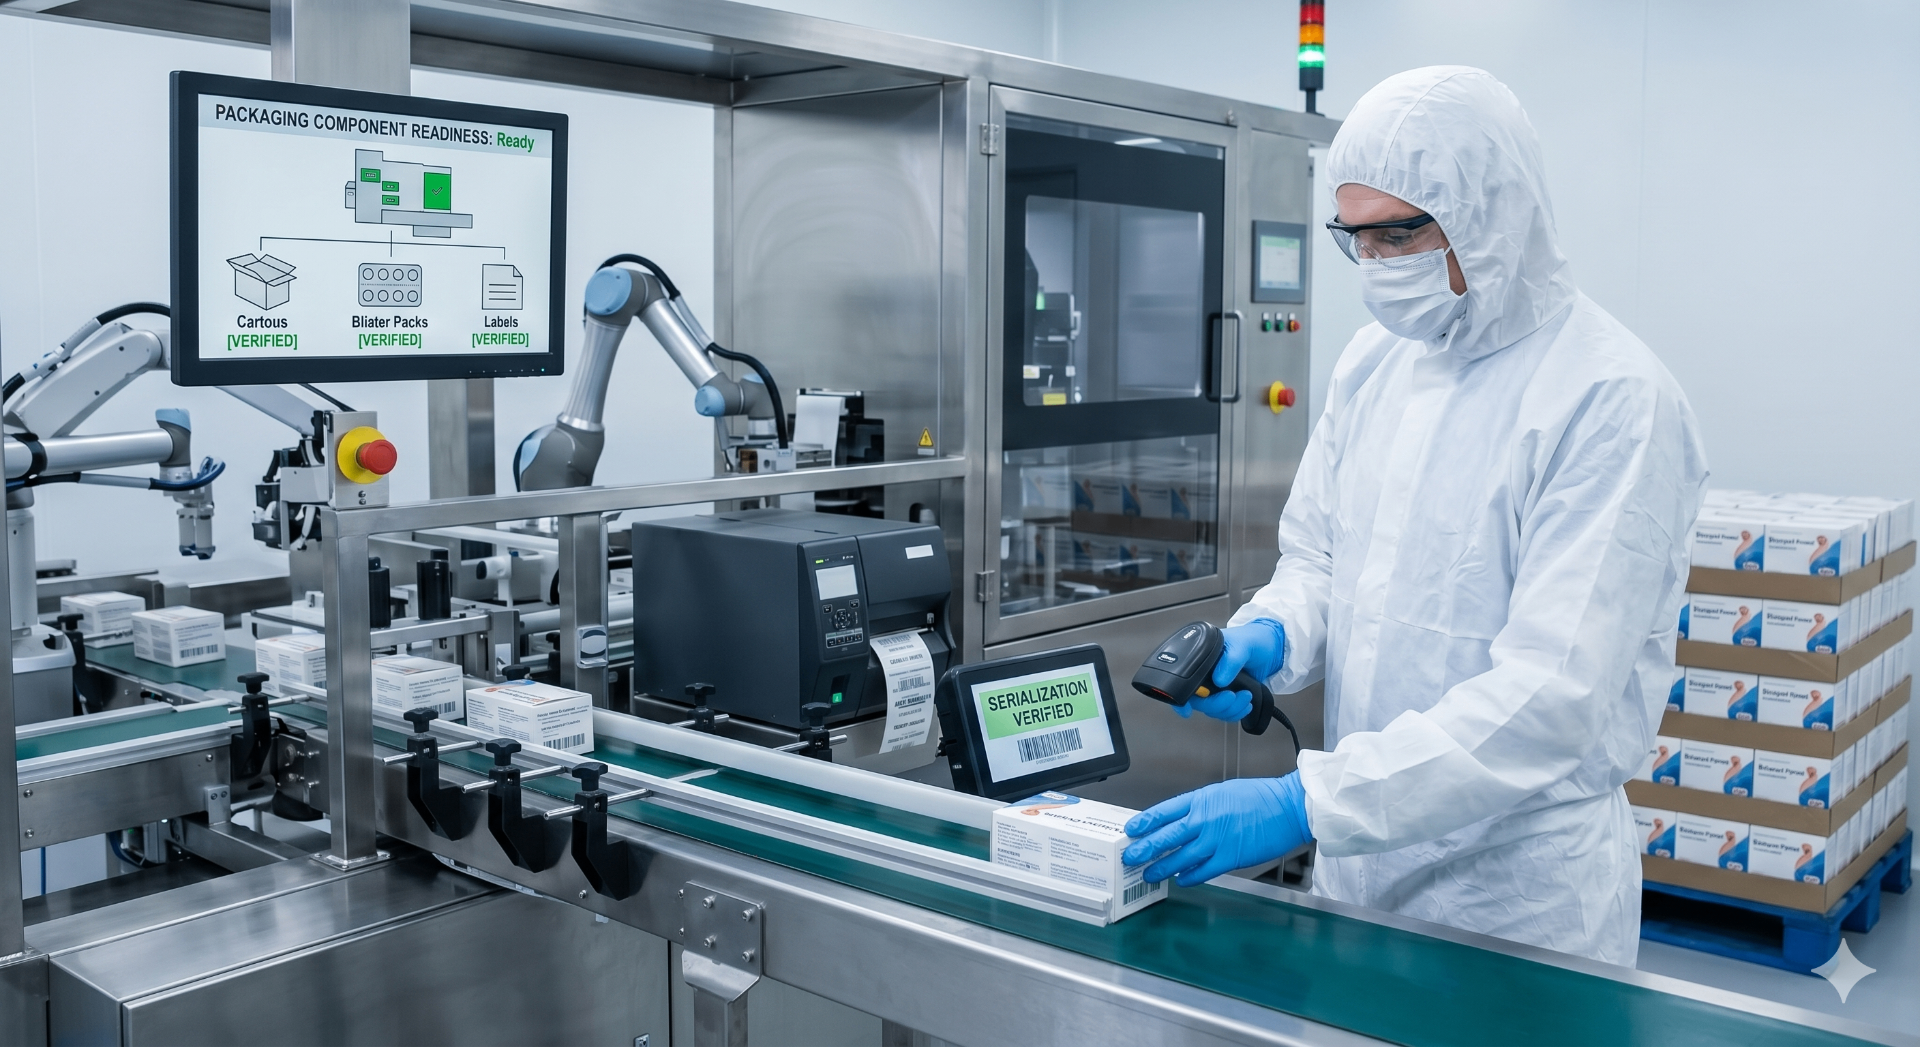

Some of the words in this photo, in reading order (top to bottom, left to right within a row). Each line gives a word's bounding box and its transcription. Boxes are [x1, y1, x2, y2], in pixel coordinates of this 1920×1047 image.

[215, 103, 309, 128] PACKAGING
[313, 113, 408, 137] COMPONENT
[411, 123, 494, 146] READINESS:
[497, 131, 535, 153] Ready
[237, 314, 288, 329] Cartous
[393, 315, 429, 329] Packs
[483, 315, 519, 329] Labels
[227, 334, 298, 351] [VERIFIED]
[358, 333, 422, 349] [VERIFIED]
[472, 332, 529, 348] [VERIFIED]
[987, 679, 1088, 712] SERIALIZATION
[1012, 702, 1074, 727] VERIFIED
